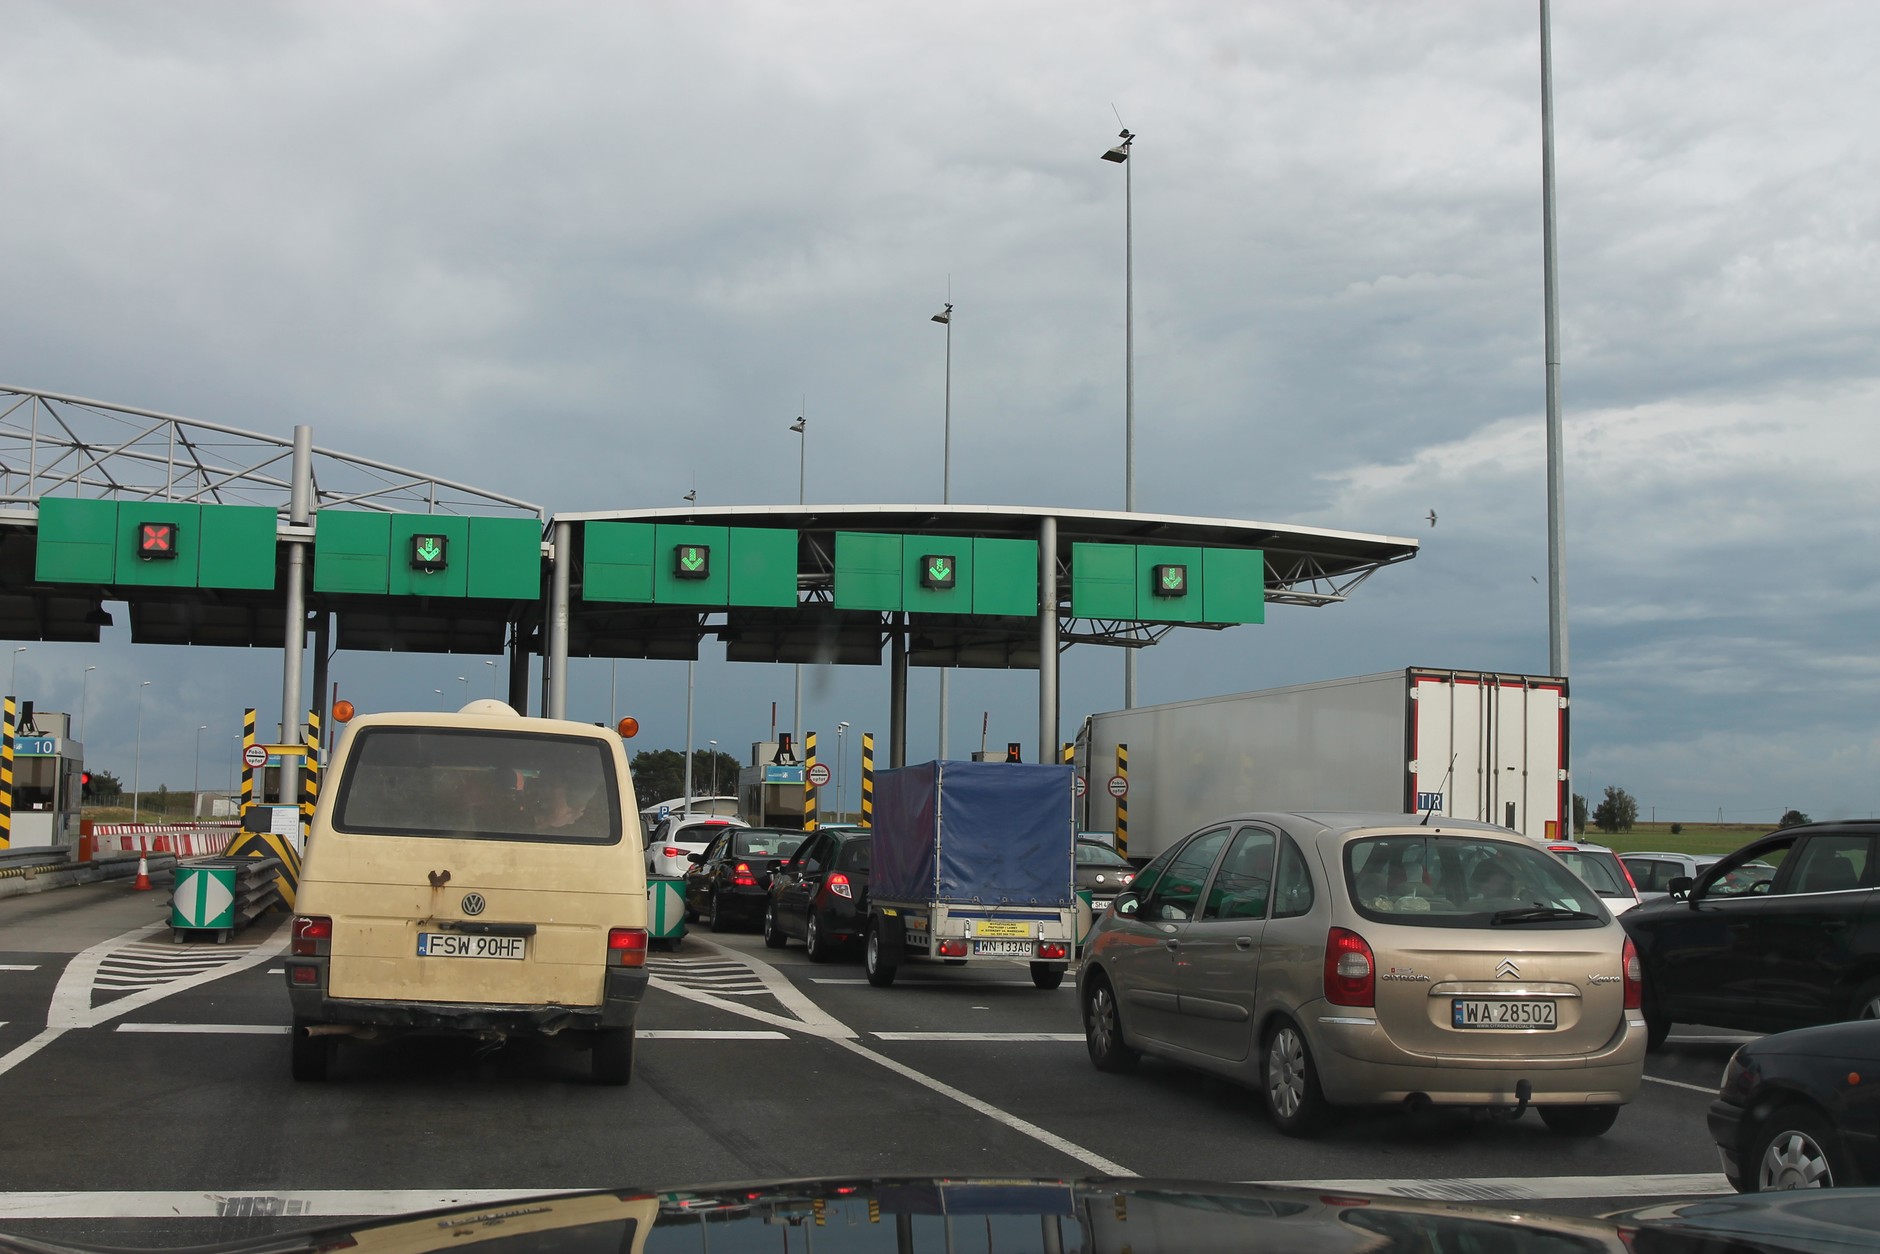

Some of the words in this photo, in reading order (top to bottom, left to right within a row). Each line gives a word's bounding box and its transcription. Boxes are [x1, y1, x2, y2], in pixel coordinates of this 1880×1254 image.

[34, 740, 53, 754] 10
[1009, 745, 1019, 760] 4
[798, 769, 804, 782] 1
[1419, 793, 1441, 810] TIR
[661, 806, 669, 815] P
[430, 936, 471, 955] FSW
[476, 937, 523, 957] 90HF
[981, 940, 997, 952] WN
[1000, 941, 1031, 953] 133AG
[1466, 1003, 1492, 1022] WA
[1499, 1003, 1553, 1023] 28502
